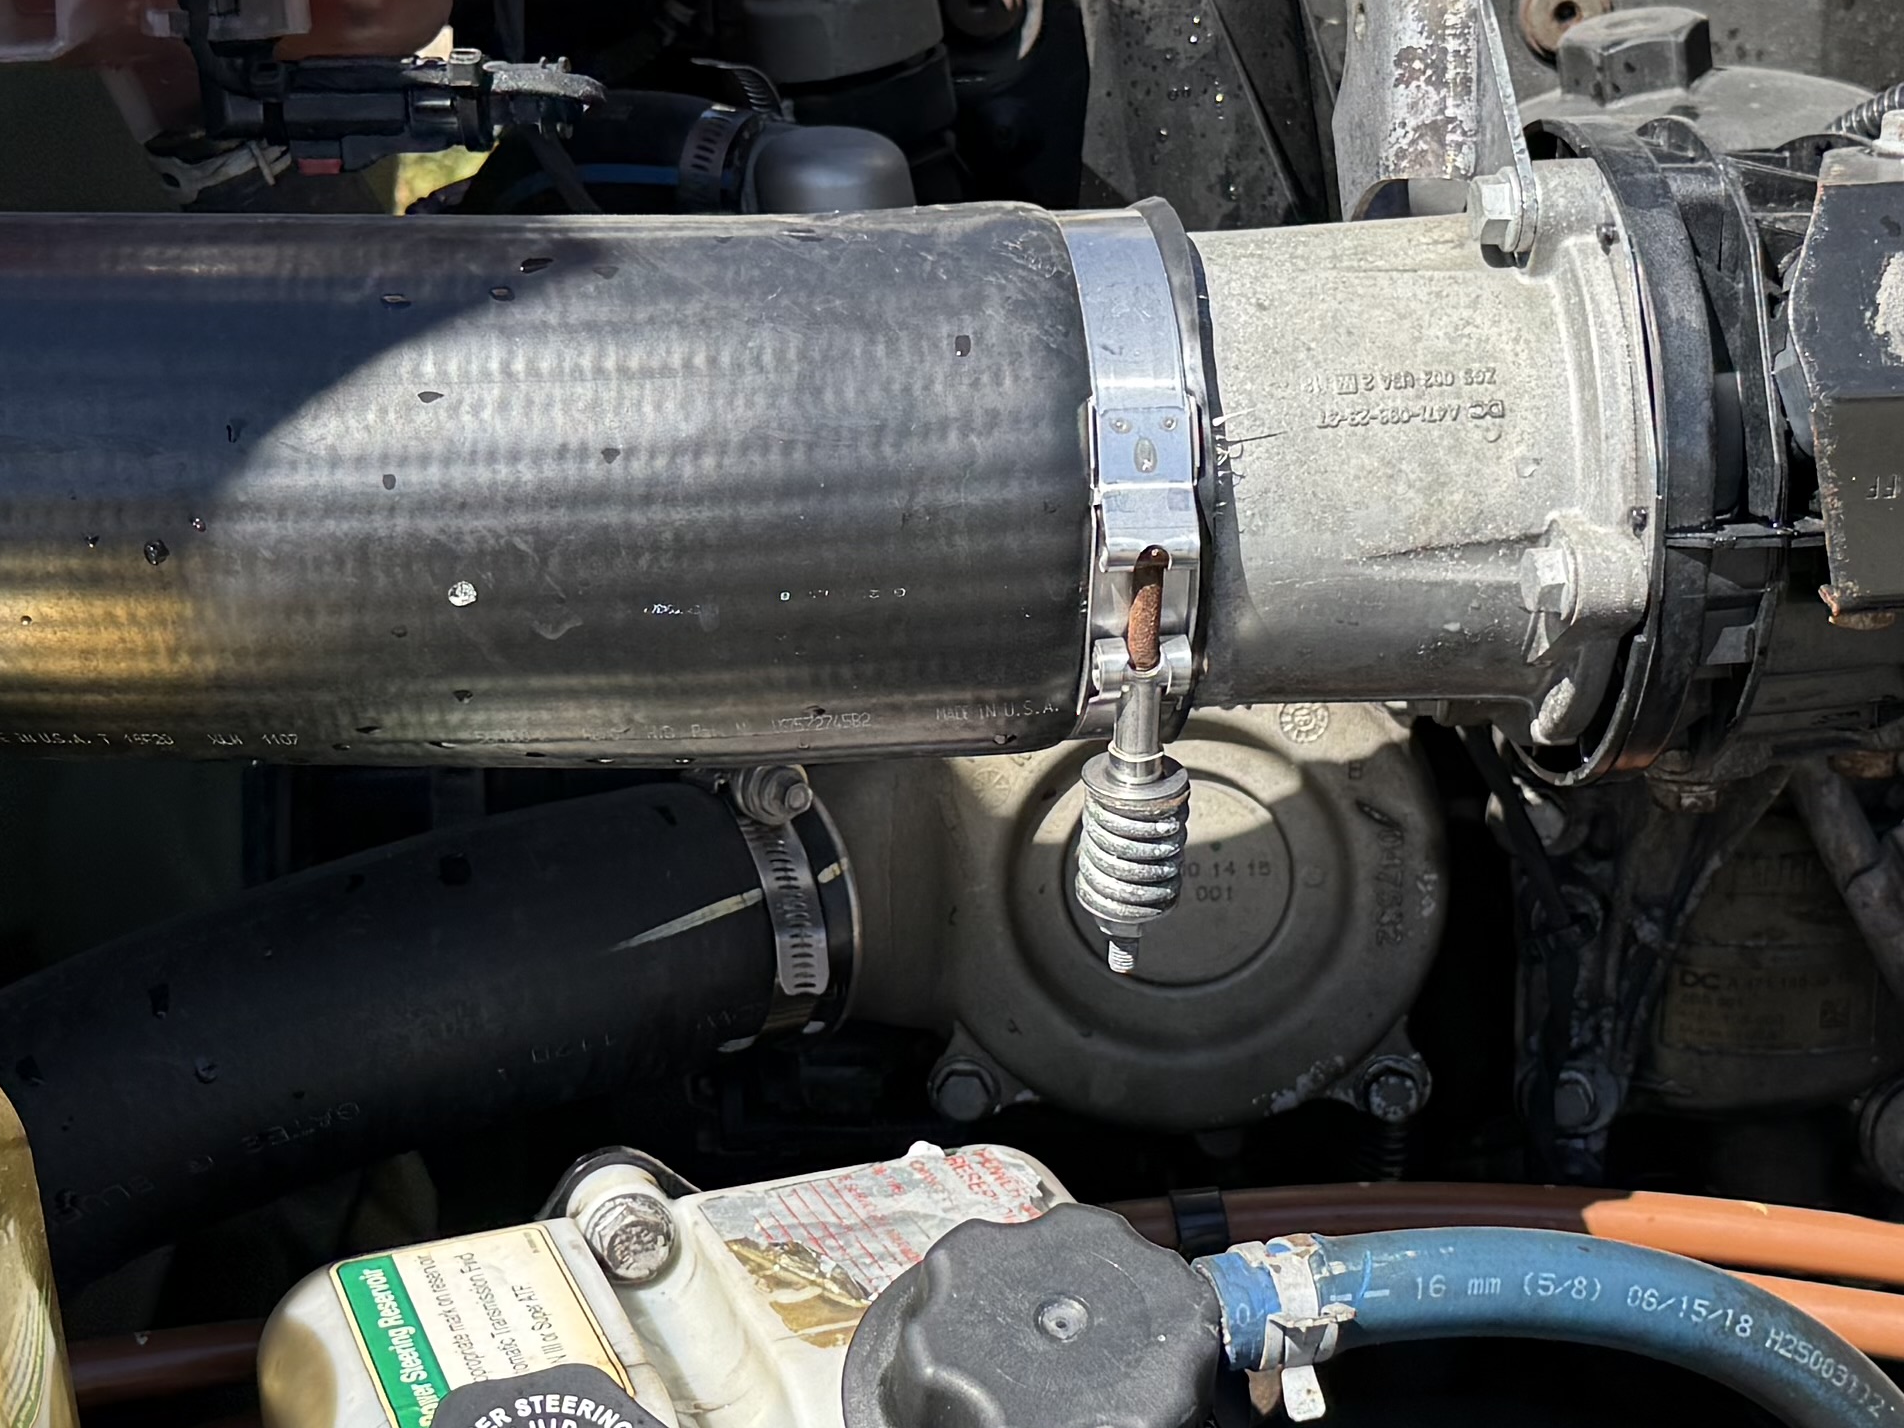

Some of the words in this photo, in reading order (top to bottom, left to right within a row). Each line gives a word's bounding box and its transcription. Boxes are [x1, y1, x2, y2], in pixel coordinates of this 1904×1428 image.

[978, 703, 997, 719] IN
[1004, 702, 1060, 718] U.S.A.
[359, 1268, 405, 1329] Reservoir
[435, 1290, 454, 1307] on
[441, 1305, 464, 1333] mark
[469, 1272, 513, 1338] Transmission
[526, 1302, 553, 1332] Super
[1413, 1276, 1447, 1300] 16
[1467, 1274, 1502, 1297] mm
[1522, 1272, 1603, 1302] (5/8)
[1625, 1285, 1754, 1339] 06/15/18
[389, 1325, 428, 1383] Steering
